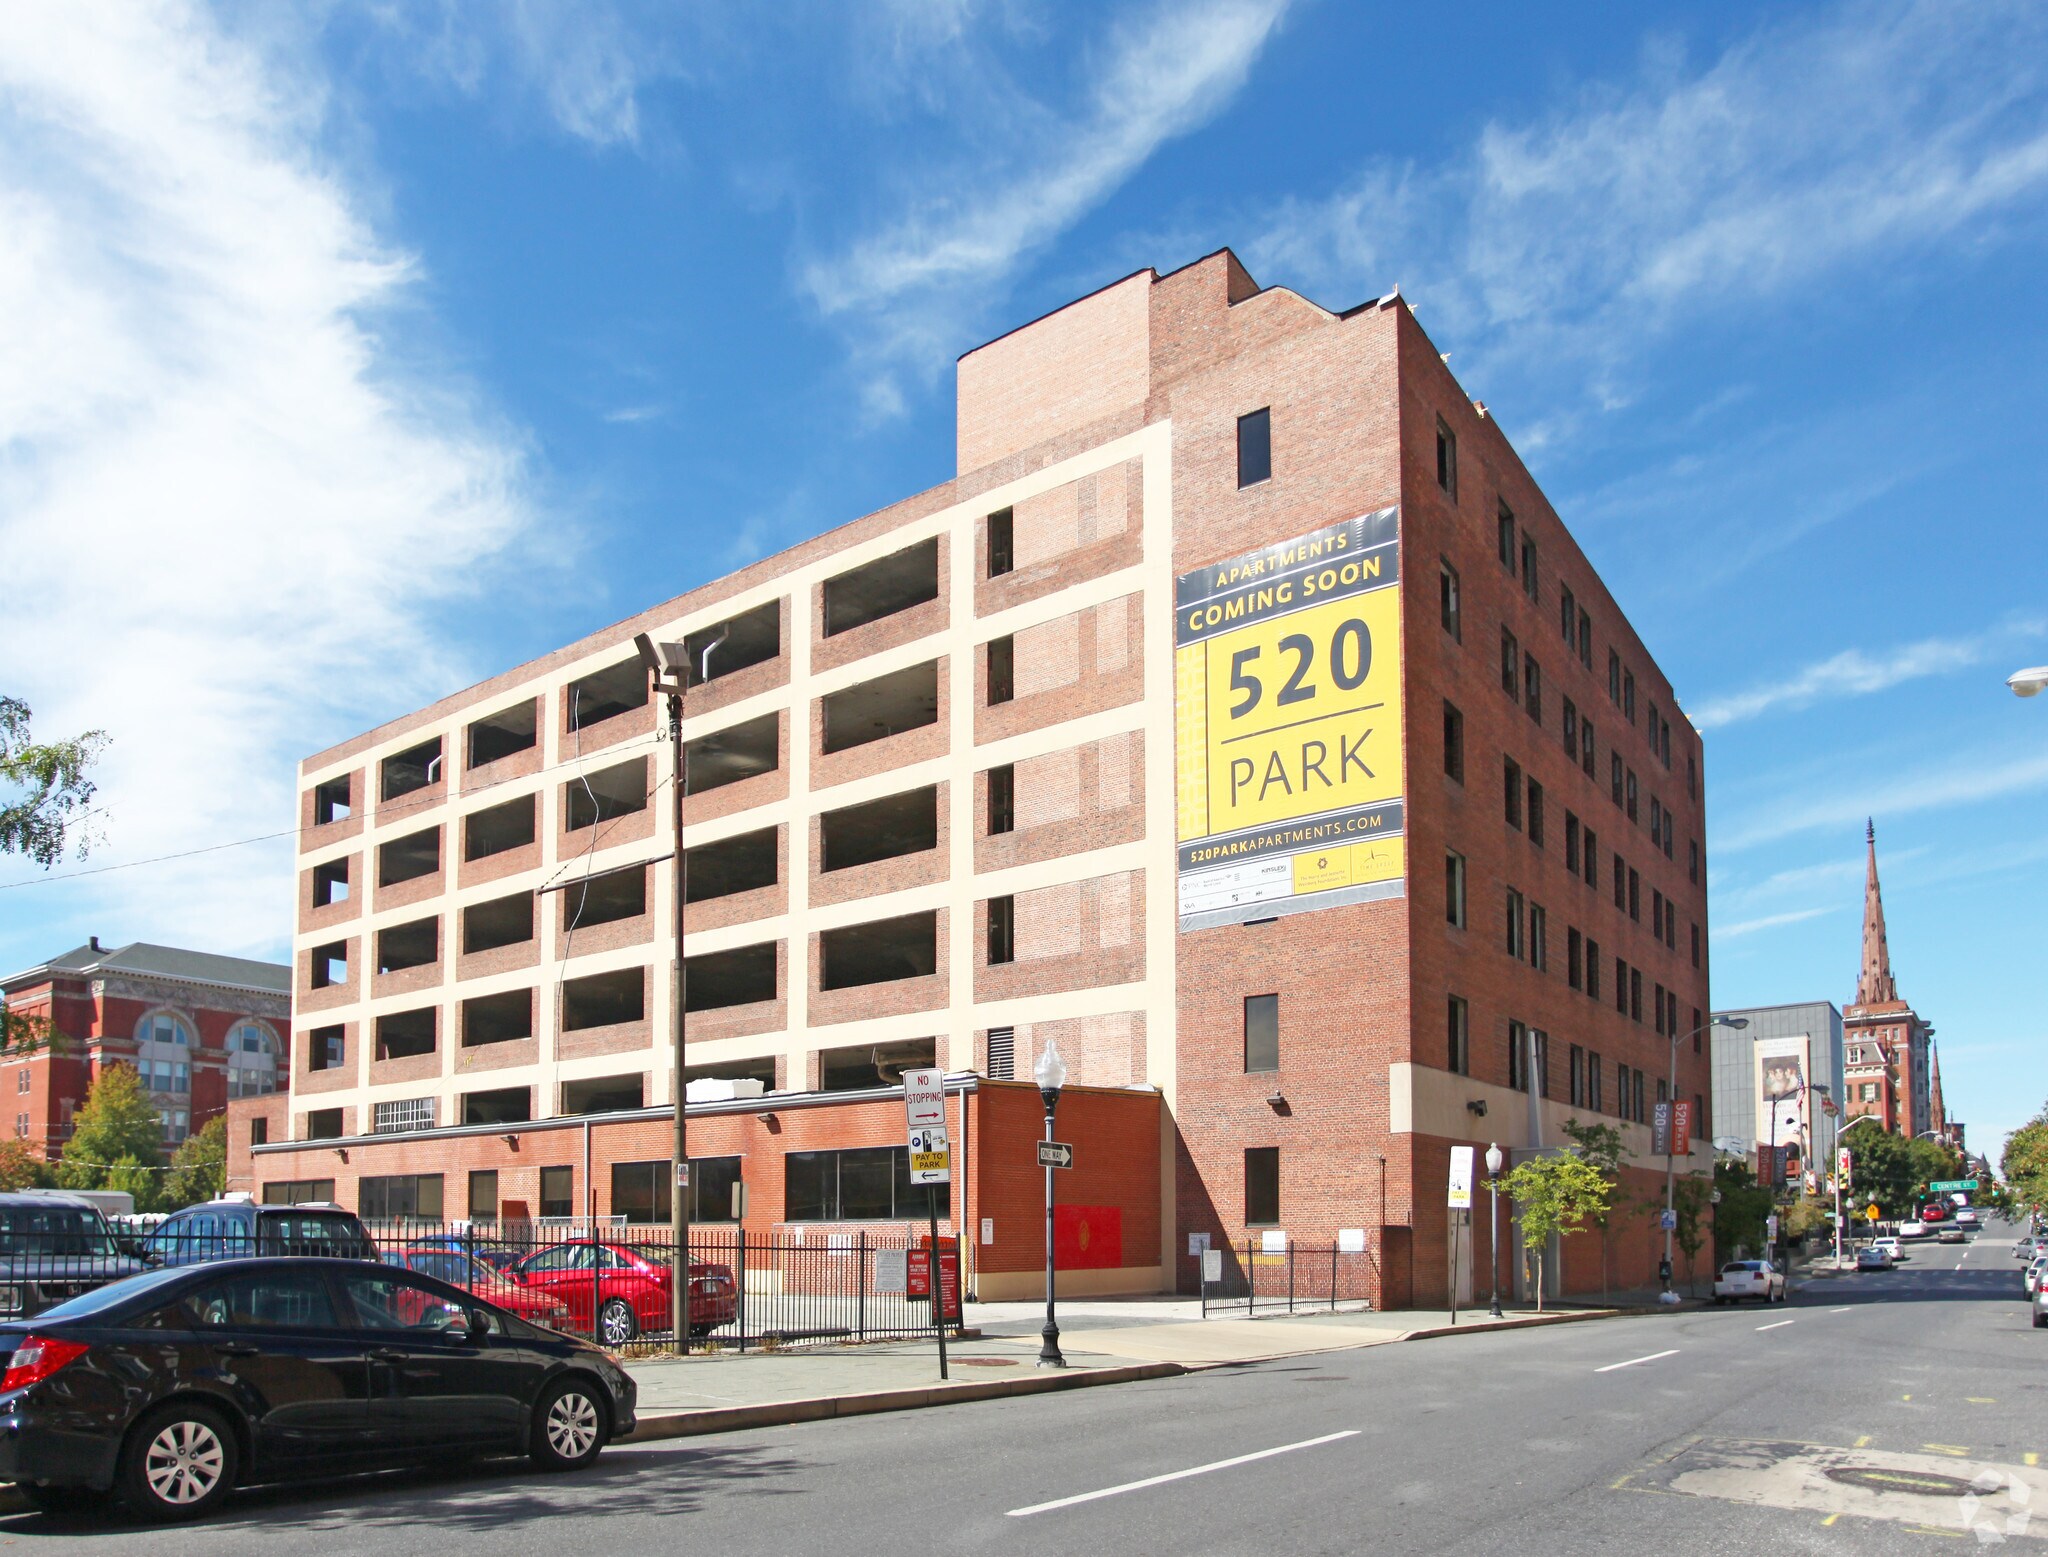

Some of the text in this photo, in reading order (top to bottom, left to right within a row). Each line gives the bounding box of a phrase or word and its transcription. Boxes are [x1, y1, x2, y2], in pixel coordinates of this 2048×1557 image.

[1216, 532, 1348, 588] APARTMENTS
[1189, 556, 1381, 631] COMING SOON
[1229, 618, 1372, 720] 520
[1230, 728, 1376, 808] PARK
[1191, 814, 1382, 863] 520PARKAPARTMENTS.COM
[917, 1075, 929, 1086] NO
[908, 1091, 942, 1104] STOPPING
[1655, 1104, 1667, 1126] 520
[1675, 1103, 1687, 1126] 520
[915, 1152, 943, 1161] PAY TO
[919, 1161, 940, 1169] PARK
[1041, 1149, 1063, 1160] ONE WAY
